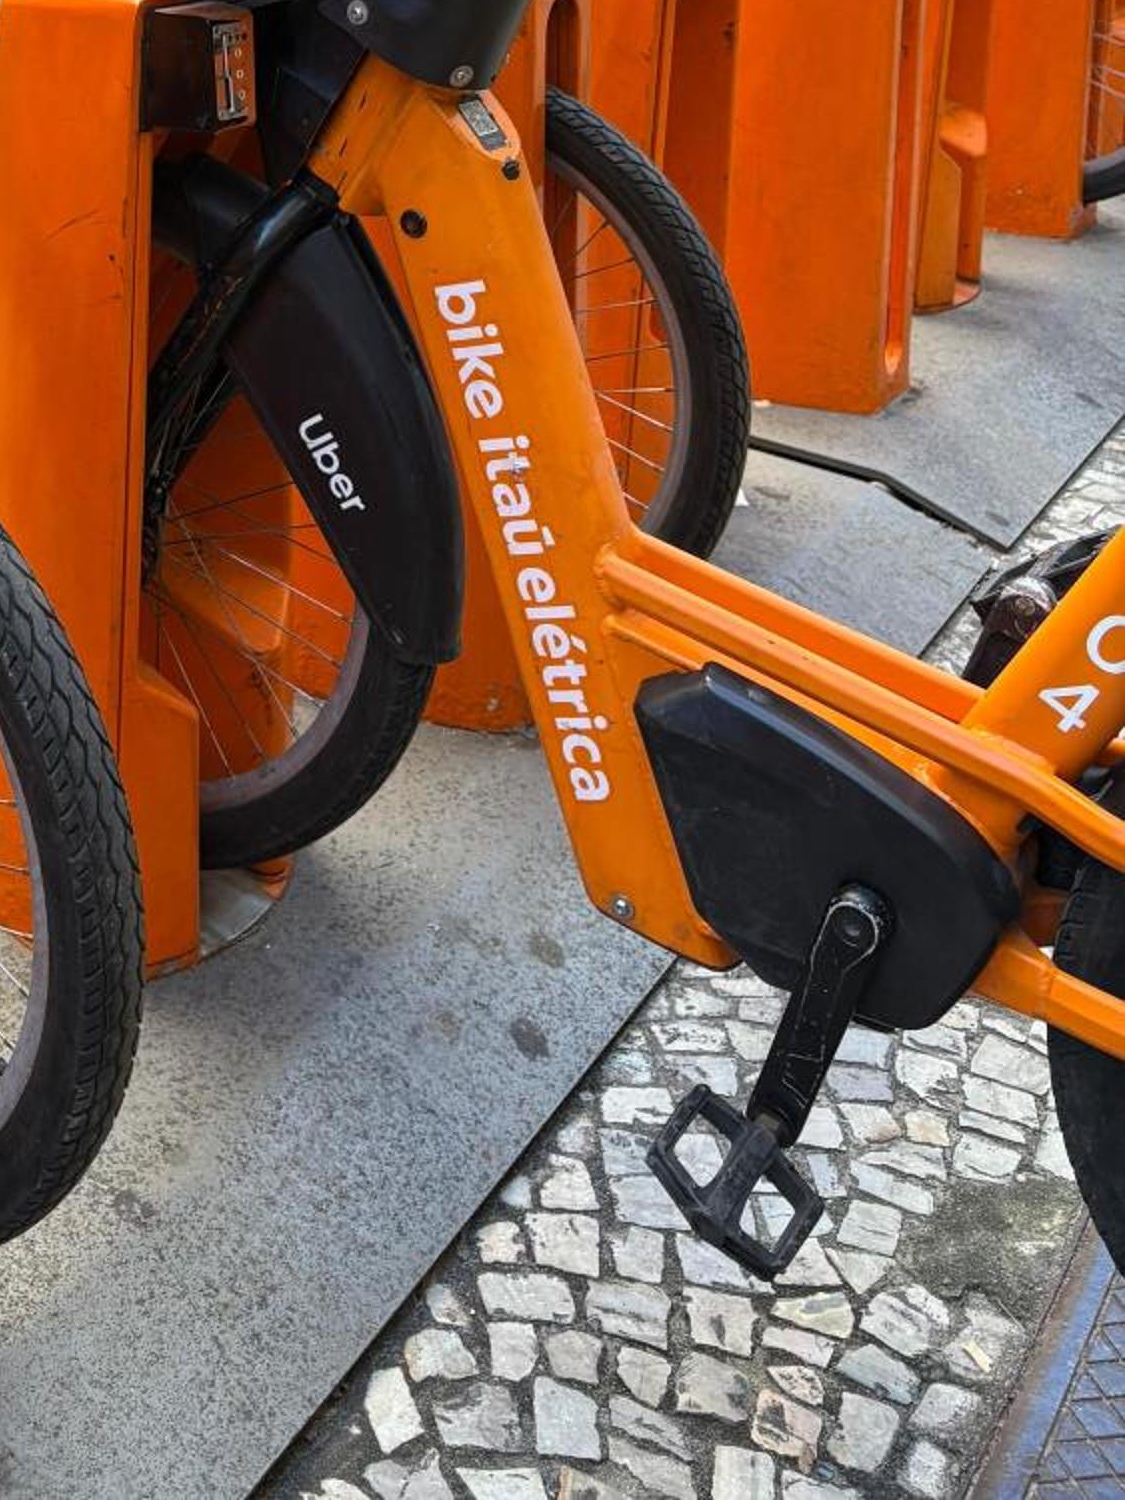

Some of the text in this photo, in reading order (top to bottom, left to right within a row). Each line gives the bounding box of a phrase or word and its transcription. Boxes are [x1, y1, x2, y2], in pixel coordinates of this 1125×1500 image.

[299, 413, 366, 511] Uber
[434, 279, 610, 803] bike itaú elétrica
